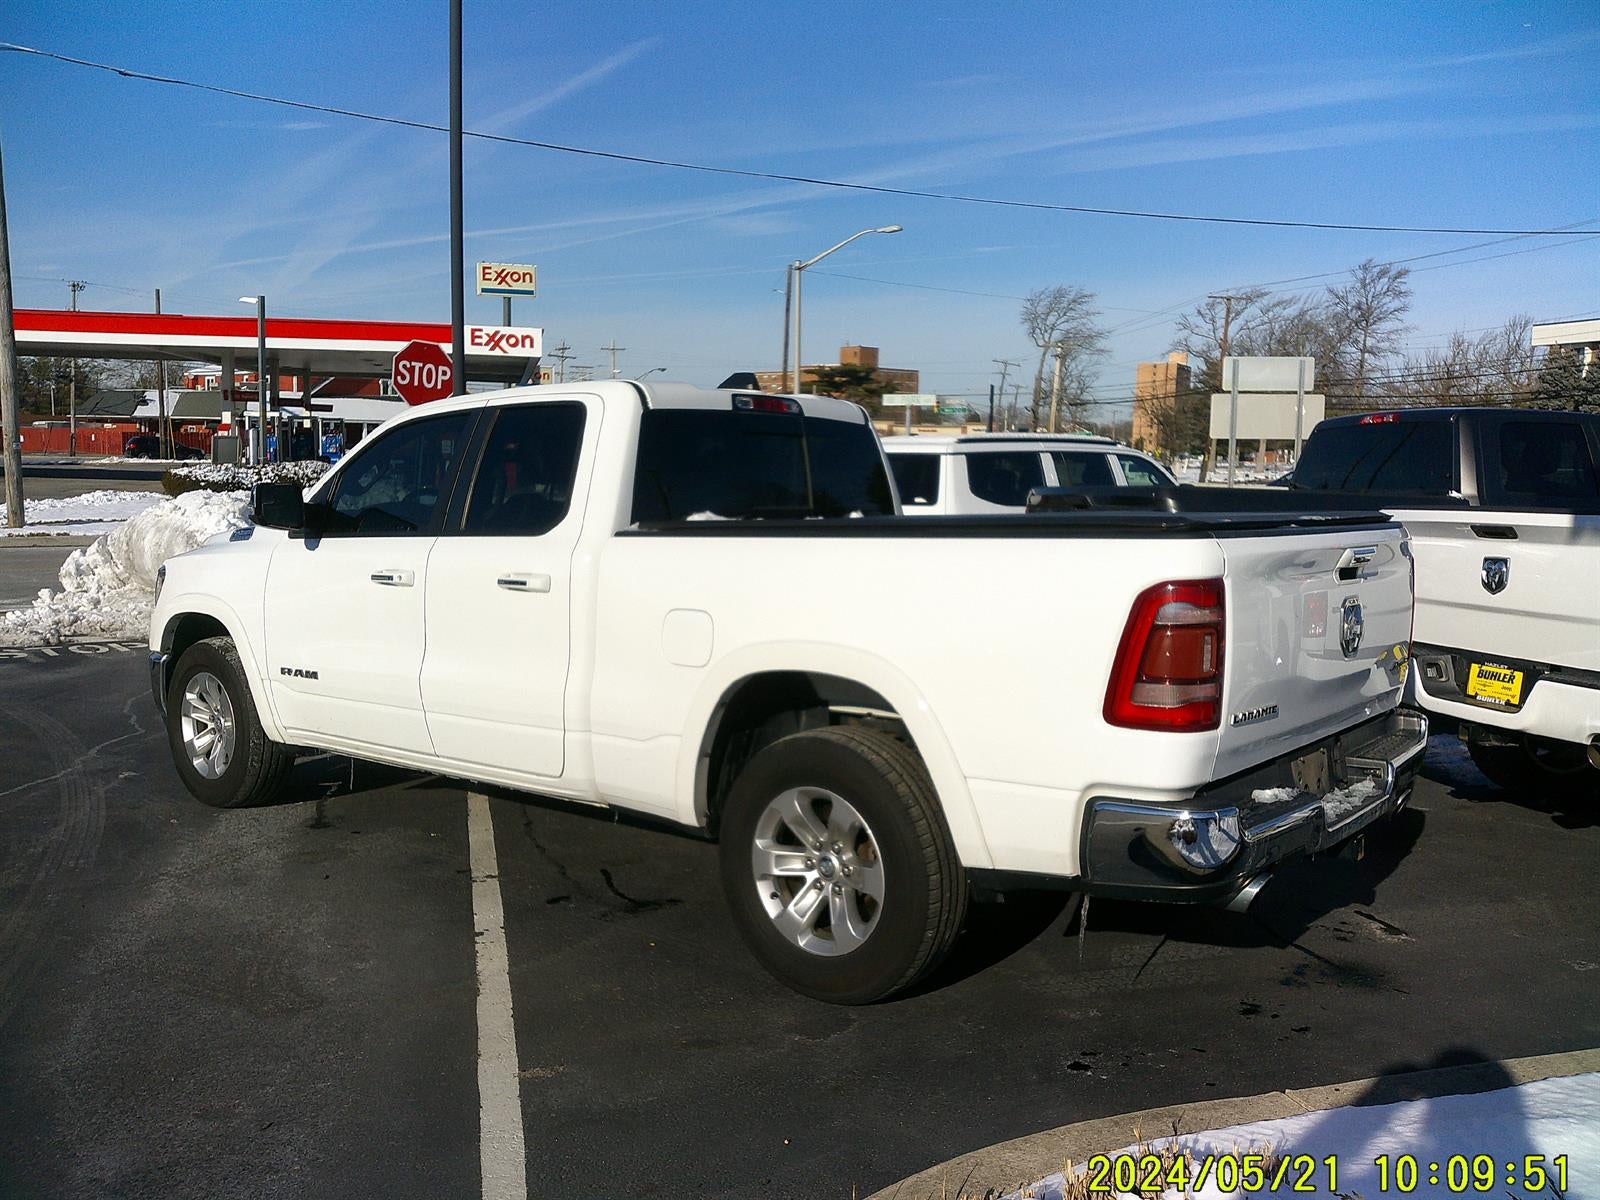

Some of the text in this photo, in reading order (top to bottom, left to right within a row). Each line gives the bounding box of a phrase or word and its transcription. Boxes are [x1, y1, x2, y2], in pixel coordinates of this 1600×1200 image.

[481, 266, 533, 287] Exxon
[470, 328, 534, 353] Exxon
[397, 360, 451, 390] STOP
[280, 667, 319, 680] RAM
[1477, 669, 1516, 684] BUHLER
